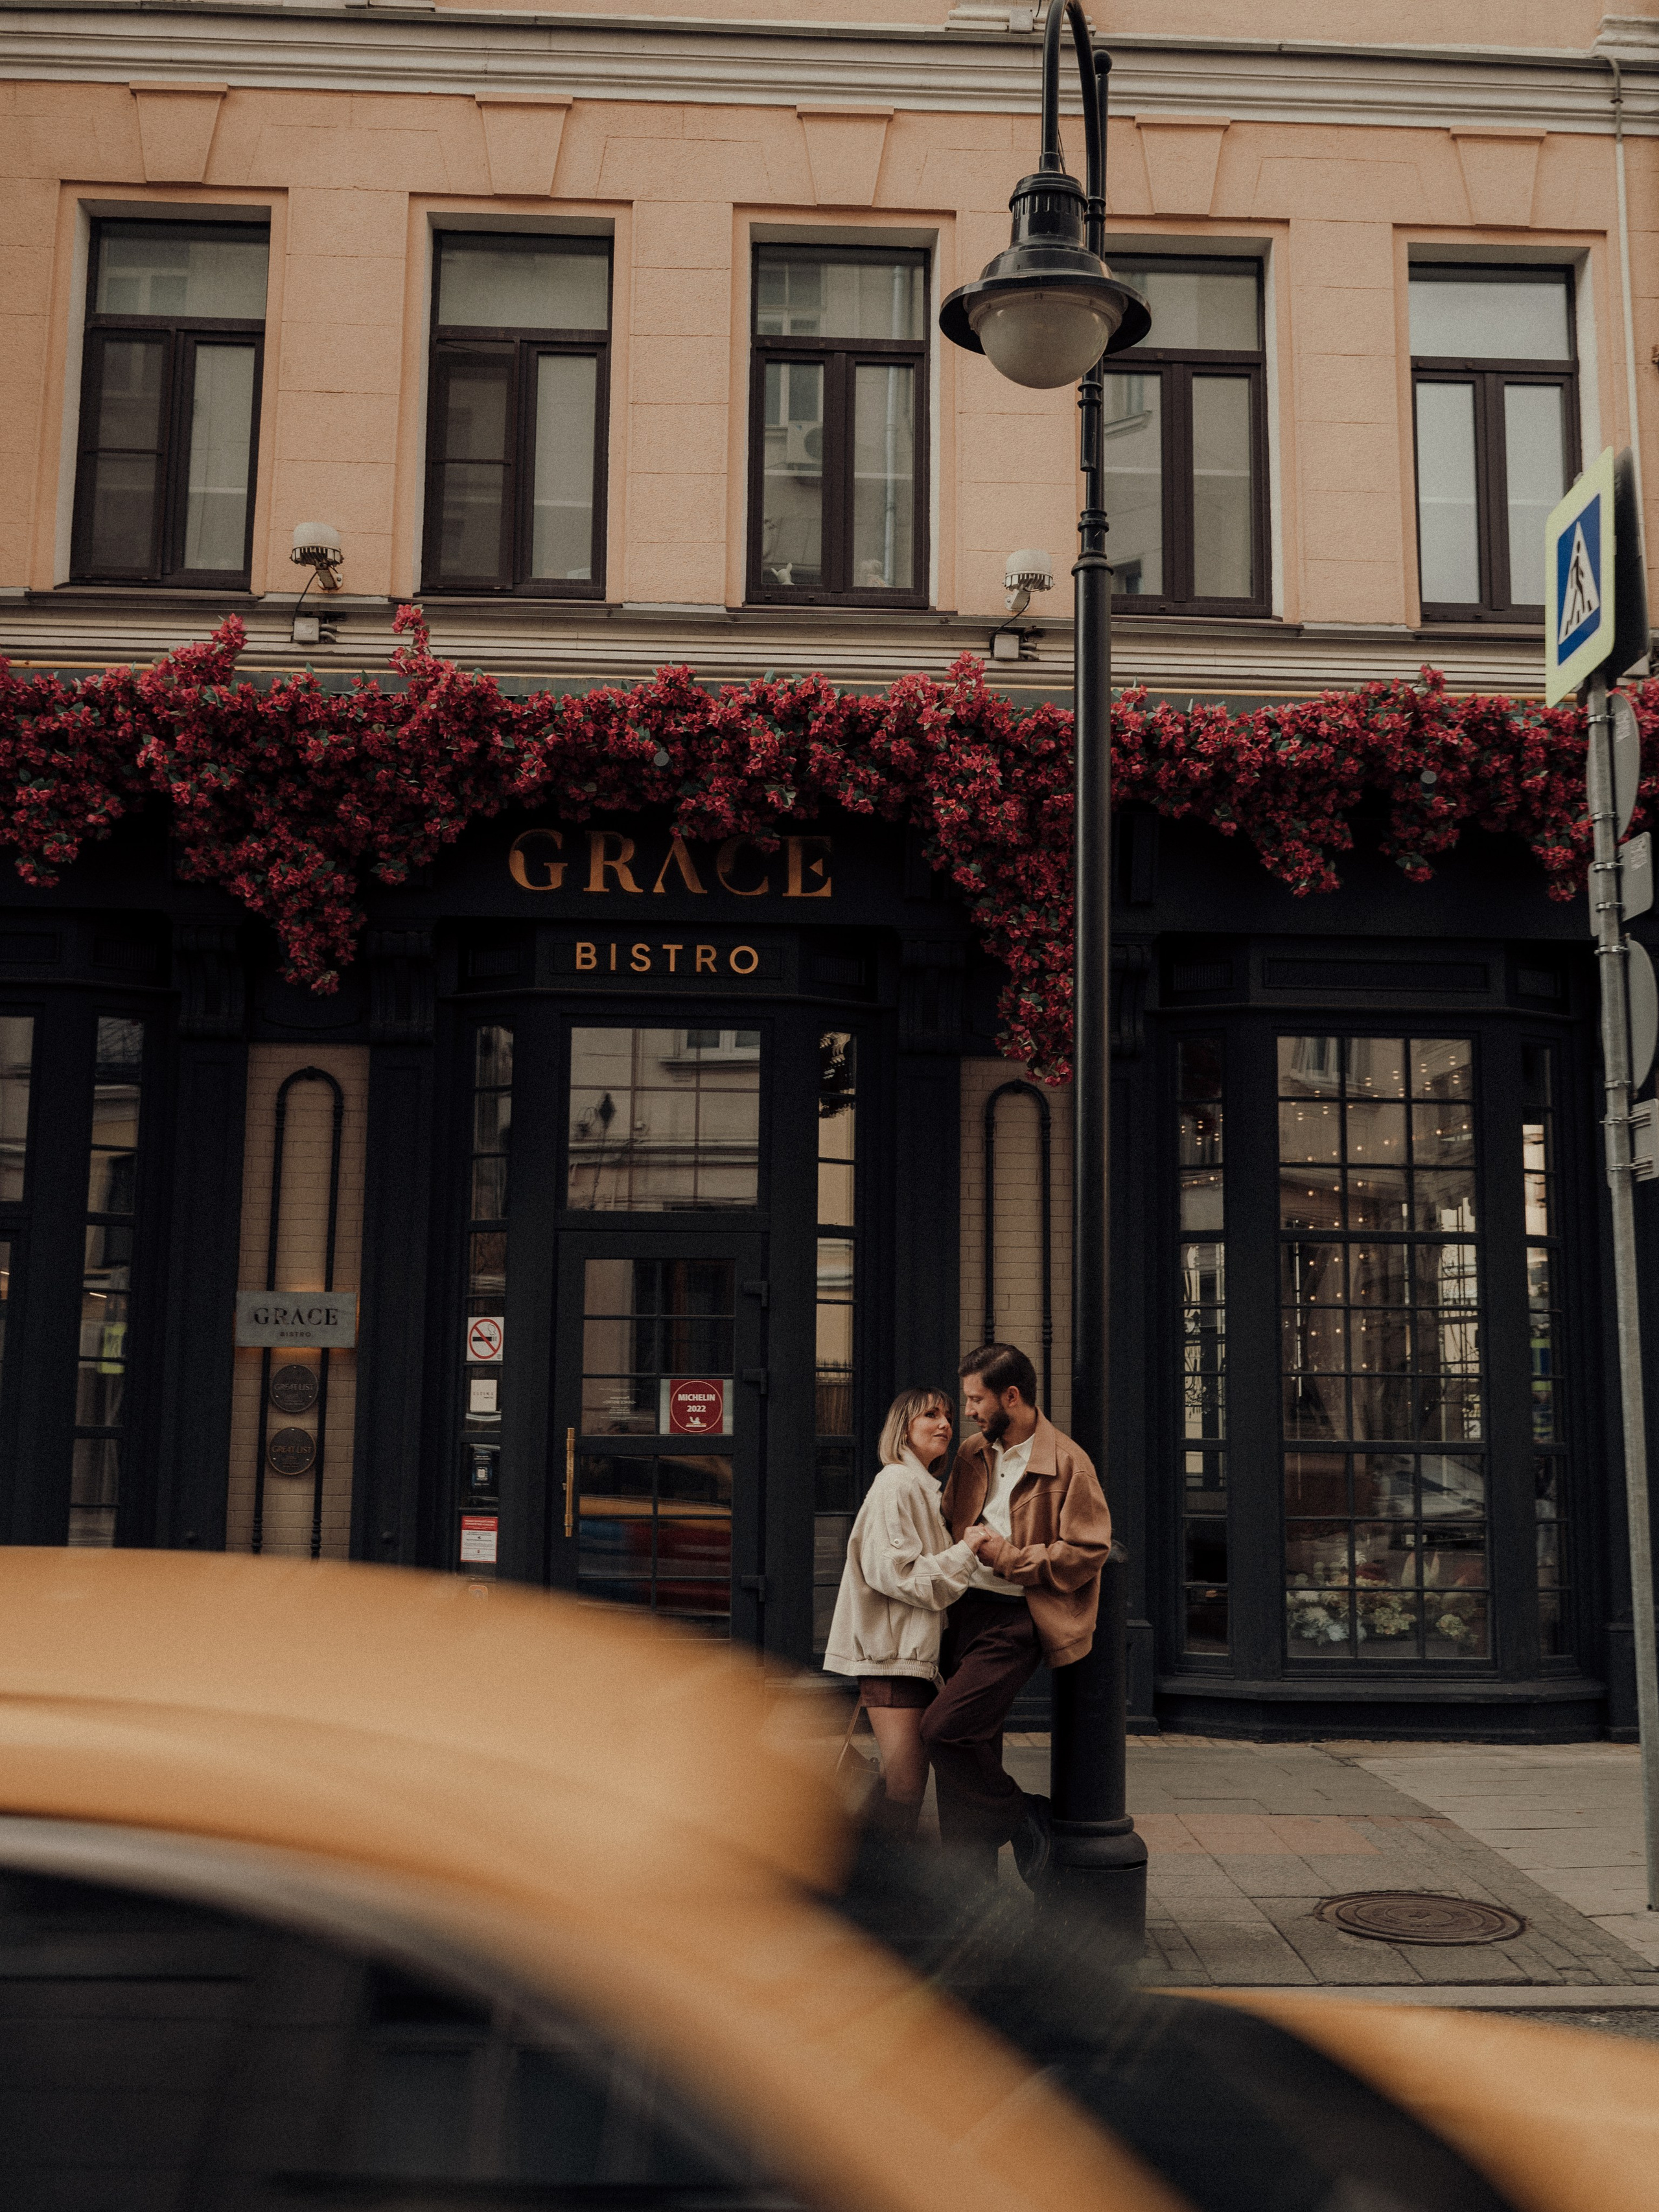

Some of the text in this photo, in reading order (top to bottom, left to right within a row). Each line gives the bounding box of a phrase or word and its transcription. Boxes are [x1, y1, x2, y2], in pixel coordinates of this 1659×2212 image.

[509, 828, 832, 897] GRACE
[575, 942, 759, 974] BISTRO
[254, 1308, 338, 1325] GRACE
